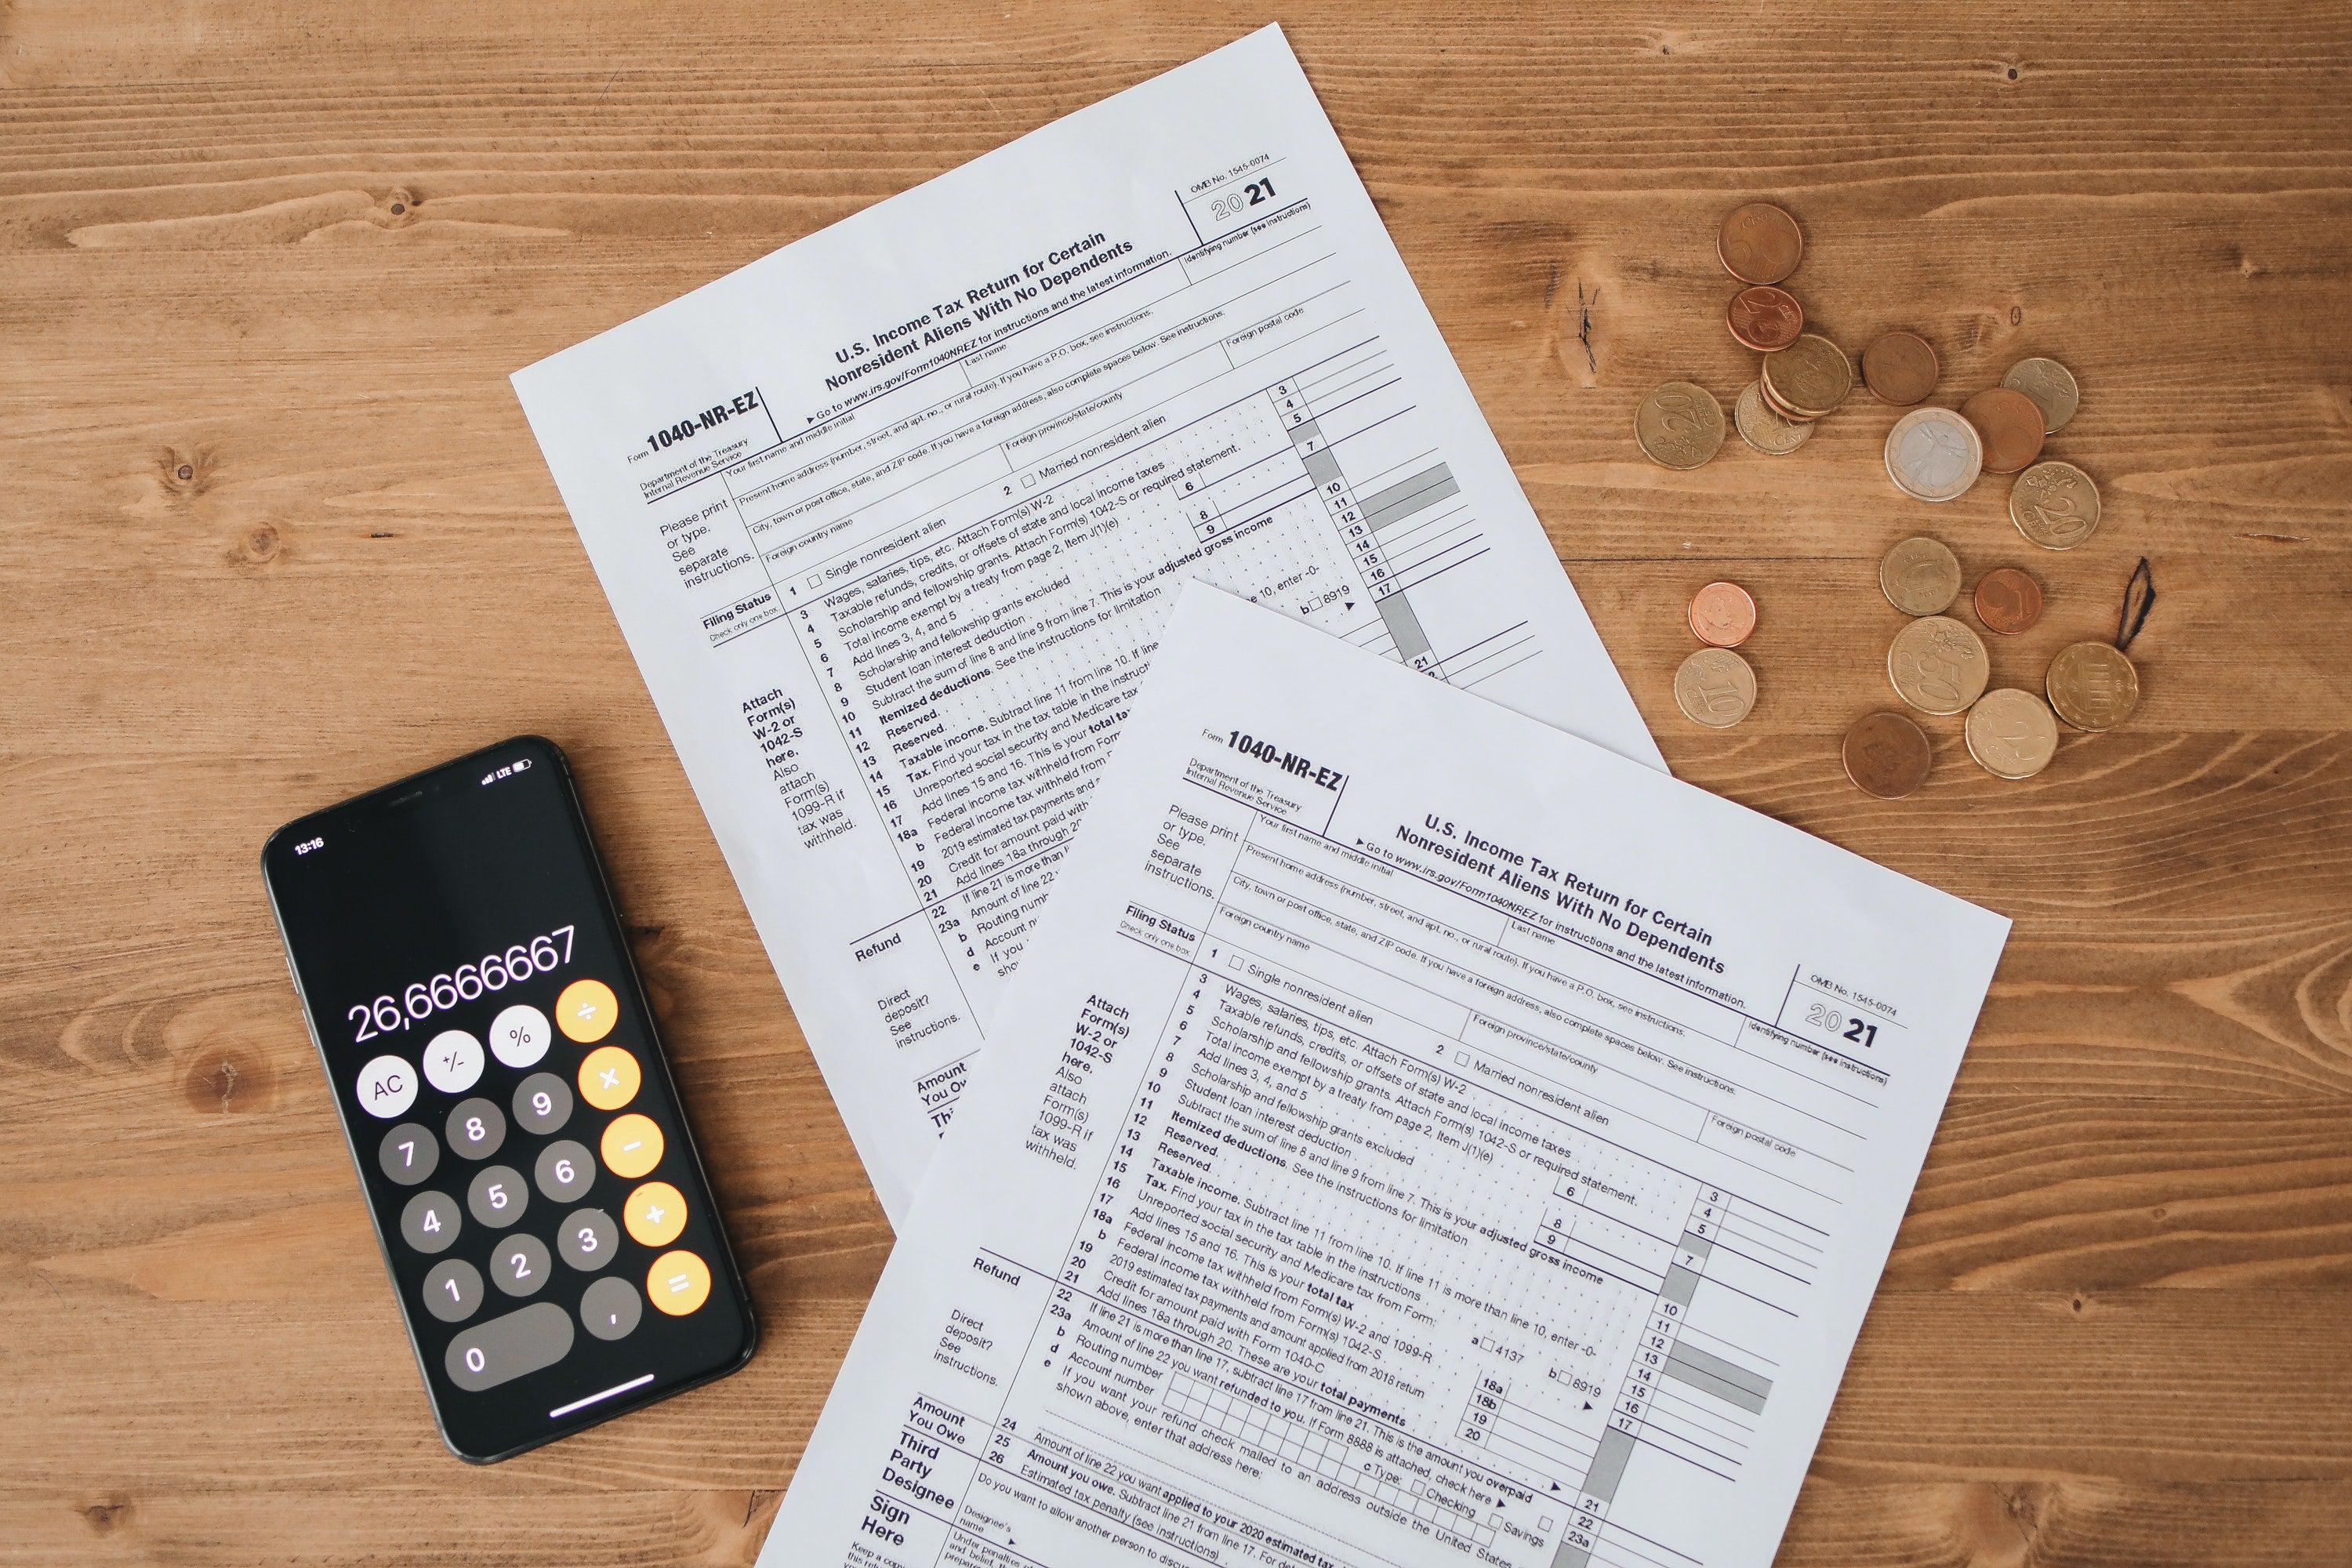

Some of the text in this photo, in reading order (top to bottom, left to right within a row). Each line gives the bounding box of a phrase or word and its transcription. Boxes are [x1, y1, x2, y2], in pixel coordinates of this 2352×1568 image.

[1191, 154, 1269, 193] OMB No. 1545-0074
[835, 233, 1105, 363] U.S. Income Tax Return for Certain
[825, 241, 1132, 390] Nonresident Aliens With No Dependents
[816, 409, 830, 419] Go
[844, 339, 977, 406] www.irs.gov/Form1040NREZ
[978, 334, 991, 343] for
[994, 307, 1049, 336] instructions
[1051, 296, 1069, 310] and
[1070, 290, 1085, 300] the
[1087, 275, 1114, 293] latest
[1114, 251, 1171, 280] information.
[647, 390, 758, 452] 1040-NR-EZ
[1654, 393, 1703, 432] 20
[627, 451, 648, 463] Form
[1039, 416, 1166, 478] Married nonresident alien
[659, 499, 728, 535] Please print
[2034, 497, 2087, 538] 20
[667, 526, 710, 548] or type.
[826, 519, 946, 579] Single nonresident alien
[672, 547, 695, 561] See
[679, 548, 728, 575] separate
[684, 554, 754, 588] instructions.
[702, 594, 771, 629] Filing Status
[1917, 652, 1960, 701] 50
[742, 688, 782, 713] Attach
[747, 698, 795, 726] Form(s)
[1699, 681, 1745, 717] 10
[753, 716, 794, 739] W-2 or
[760, 727, 803, 753] 1042-S
[1202, 728, 1223, 742] Form
[766, 750, 798, 768] here.
[774, 764, 798, 781] Also
[1229, 731, 1342, 791] 1040-NR-EZ
[496, 767, 511, 779] LTE
[779, 771, 815, 794] attach
[1188, 758, 1238, 784] Department
[1250, 784, 1263, 800] the
[1261, 789, 1301, 811] Treasury
[784, 781, 829, 808] Form(s)
[792, 789, 844, 820] 1099-R if
[1185, 767, 1287, 815] Internal Revenue Service
[797, 809, 843, 835] tax was
[804, 818, 856, 848] withheld.
[1163, 822, 1205, 845] or type.
[1169, 804, 1238, 842] Please print
[295, 837, 325, 857] 13:16
[1157, 833, 1179, 850] See
[1151, 849, 1201, 876] separate
[1145, 860, 1214, 898] instructions.
[1425, 814, 1711, 946] U.S. Income Tax Return for Certain
[1396, 825, 1724, 973] Nonresident Aliens With No Dependents
[1126, 905, 1195, 941] Filing Status
[855, 933, 901, 961] Refund
[348, 925, 574, 1042] 26,6666667
[1810, 975, 1896, 1016] OMB No. 1545-0074
[877, 989, 910, 1010] Direct
[884, 995, 928, 1022] deposit?
[1086, 994, 1128, 1019] Attach
[510, 1026, 530, 1047] %
[890, 1022, 911, 1035] See
[895, 1014, 960, 1048] instructions.
[1076, 1022, 1117, 1047] W-2 or
[1081, 1008, 1129, 1039] Form(s)
[1062, 1051, 1092, 1073] here.
[1071, 1038, 1112, 1063] 1042-S
[375, 1075, 402, 1100] AC
[532, 1092, 551, 1115] 9
[1192, 1063, 1414, 1165] Scholarship and fellowship grants excluded
[466, 1117, 485, 1141] 8
[1711, 1115, 1795, 1156] Foreign postal code
[398, 1142, 414, 1167] 7
[556, 1160, 574, 1183] 6
[488, 1184, 507, 1208] 5
[423, 1210, 441, 1232] 4
[579, 1228, 597, 1251] 3
[511, 1254, 531, 1278] 2
[973, 1258, 1021, 1286] Refund
[445, 1279, 460, 1301] 1
[951, 1309, 983, 1330] Direct
[939, 1337, 960, 1353] See
[946, 1325, 993, 1350] deposit?
[466, 1348, 485, 1371] 0
[934, 1349, 996, 1385] instructions.
[1496, 1346, 1524, 1363] 4137
[1483, 1378, 1502, 1394] 18a
[1573, 1378, 1601, 1397] 8919
[913, 1396, 965, 1427] Amount
[910, 1410, 964, 1443] You Owe
[900, 1431, 940, 1459] Third
[890, 1449, 932, 1479] Party
[882, 1467, 954, 1508] Designee
[870, 1496, 909, 1524] Sign
[1427, 1488, 1475, 1518] Checking
[861, 1515, 903, 1545] Here
[1504, 1522, 1544, 1547] Savings
